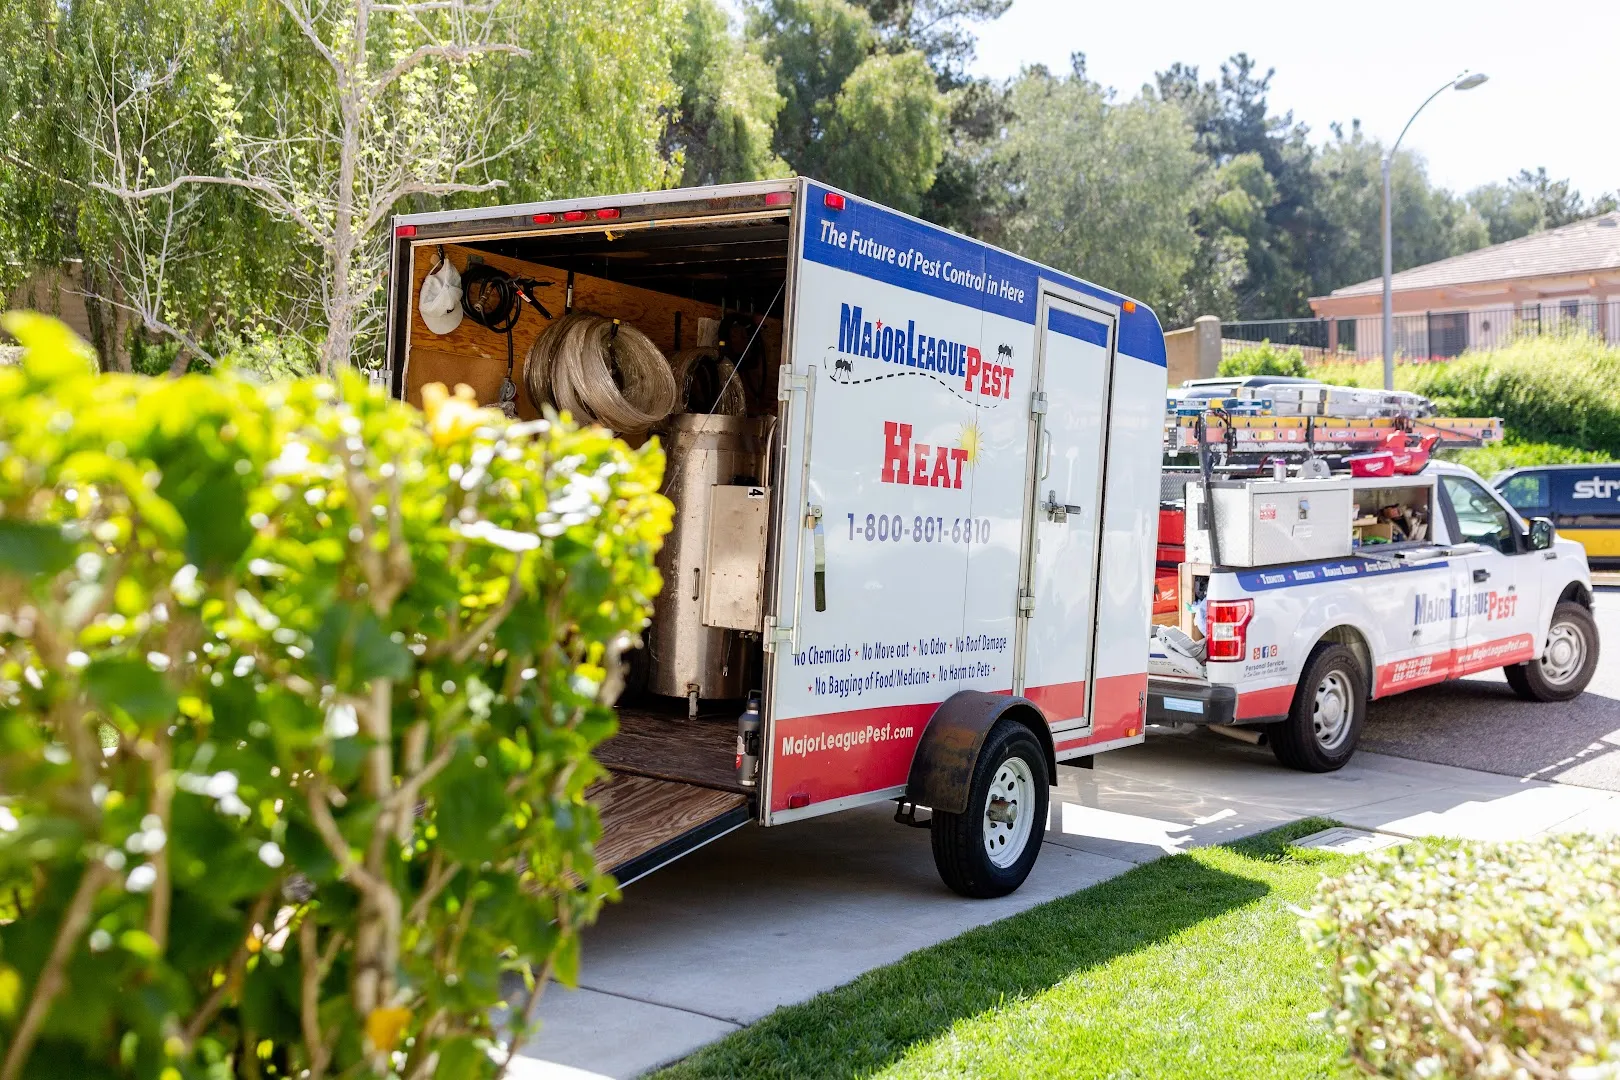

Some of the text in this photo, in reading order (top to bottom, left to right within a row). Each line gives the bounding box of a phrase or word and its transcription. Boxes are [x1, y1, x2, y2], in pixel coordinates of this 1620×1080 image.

[820, 219, 1025, 304] The Future of Pest Control in Here
[881, 420, 969, 490] HEAT
[749, 488, 764, 496] 4
[1572, 476, 1620, 502] str
[847, 512, 991, 544] 1-800-801-6810
[808, 644, 852, 666] Chemicals
[861, 642, 873, 660] No
[874, 641, 895, 659] Move
[896, 641, 909, 657] out
[918, 639, 929, 656] No
[930, 637, 947, 655] Odor
[955, 636, 964, 653] No
[965, 634, 982, 652] Roof
[982, 634, 1007, 654] Damage
[815, 661, 990, 698] No Bagging of Food/Medicine No Harm to Pets
[782, 722, 914, 758] MajorLeaguePest.com
